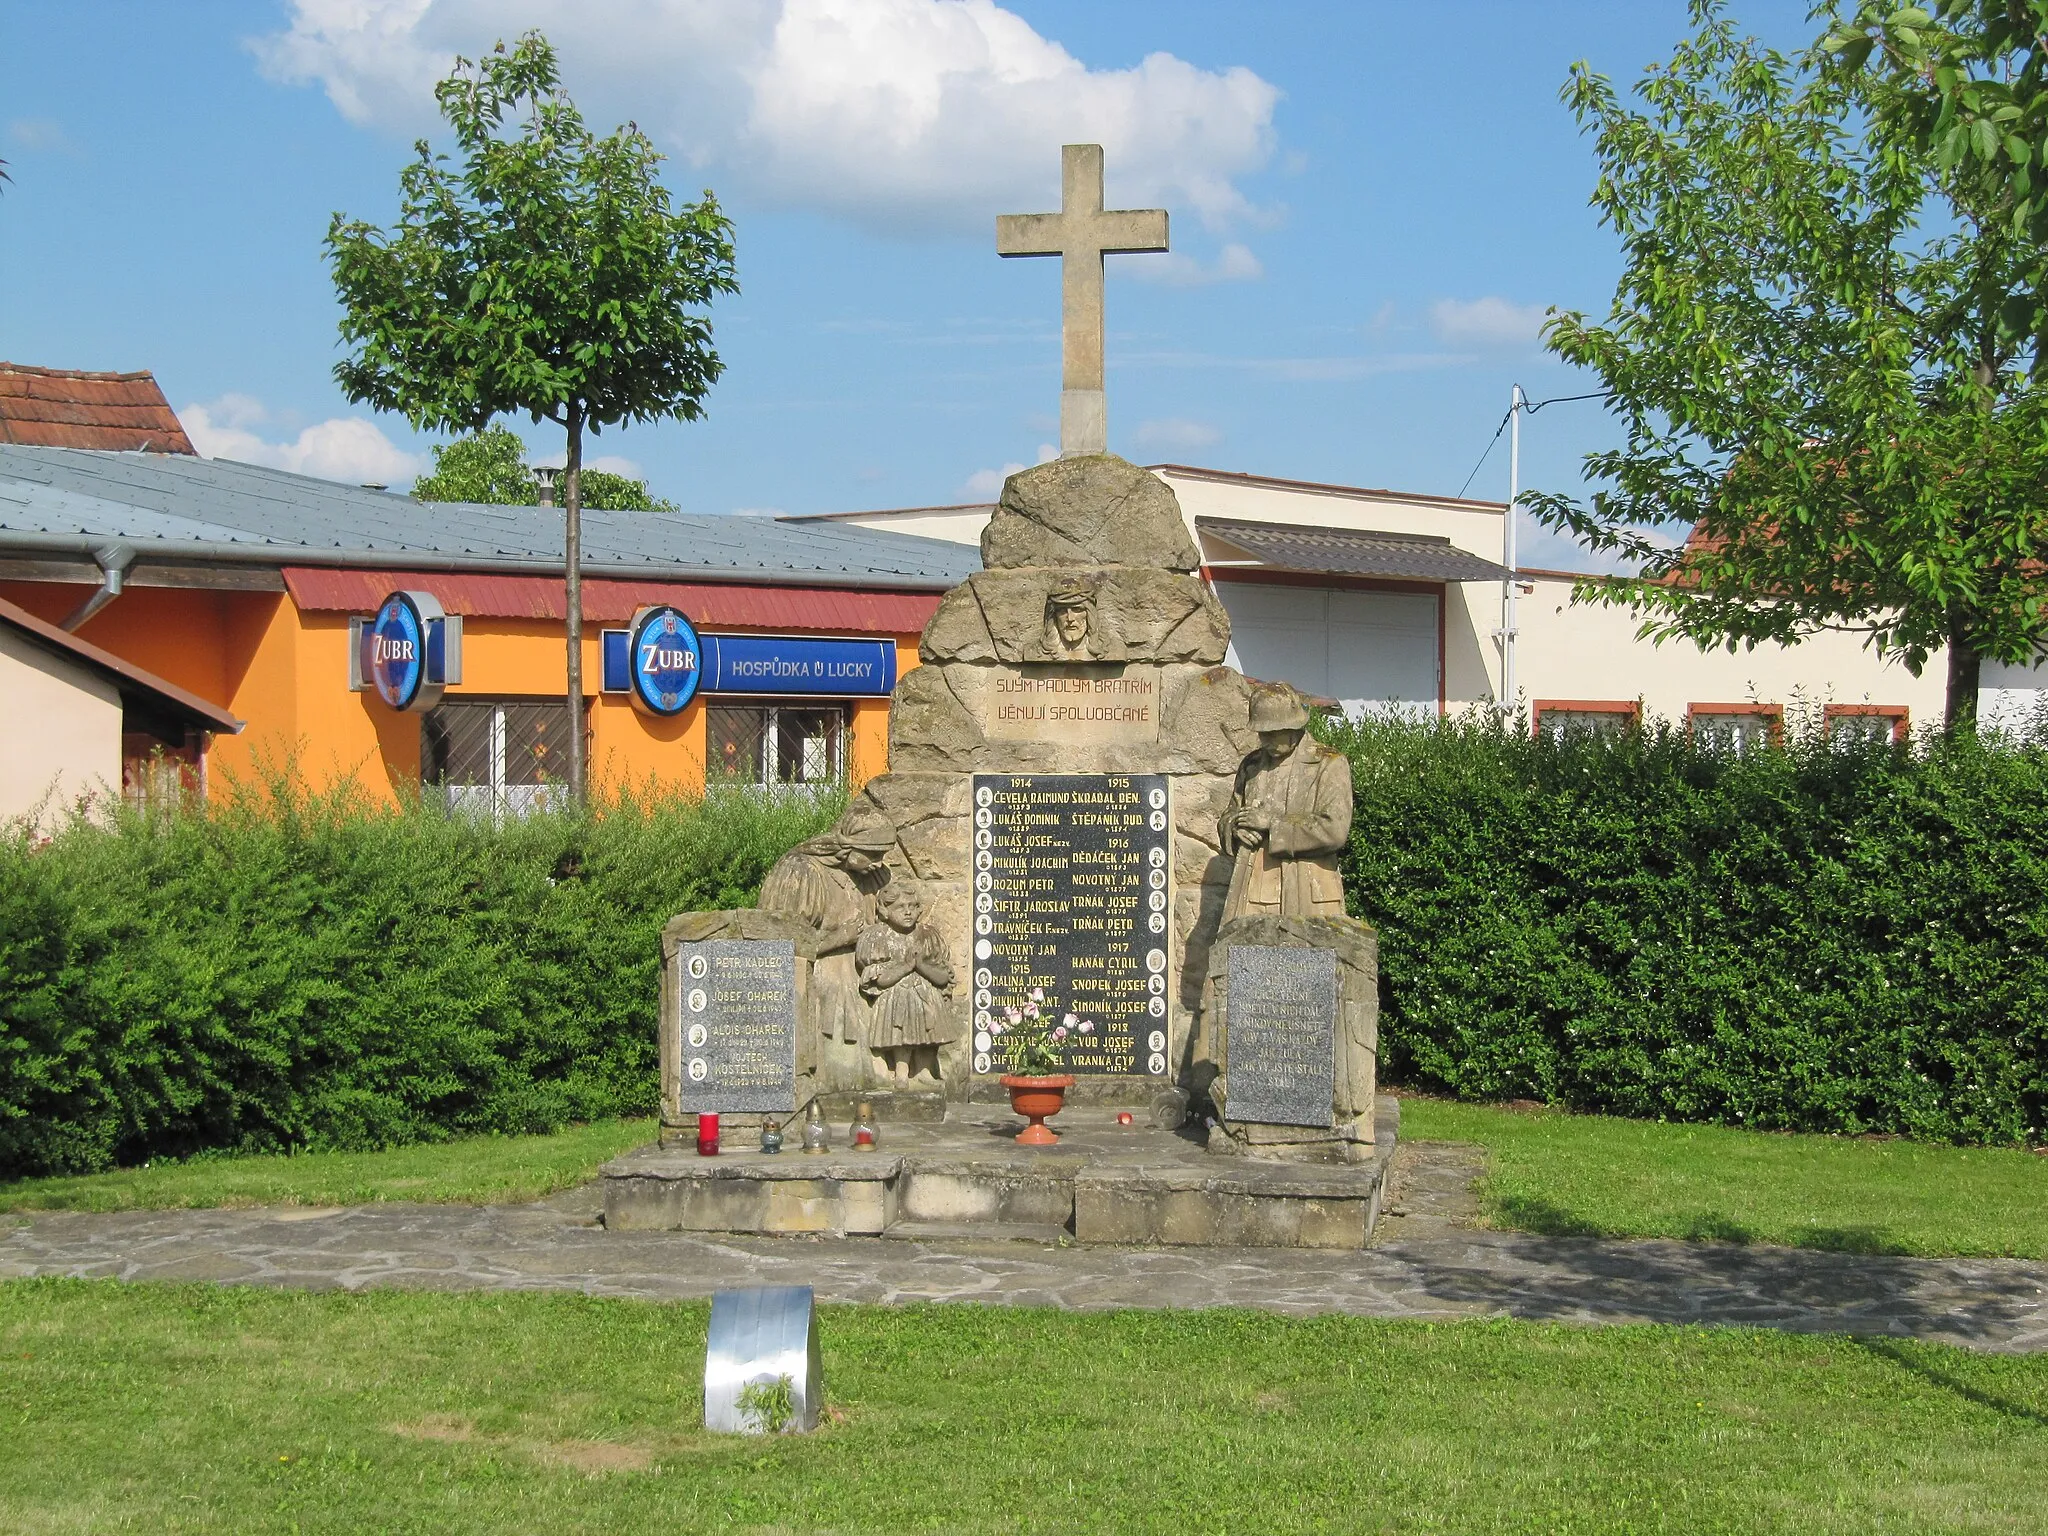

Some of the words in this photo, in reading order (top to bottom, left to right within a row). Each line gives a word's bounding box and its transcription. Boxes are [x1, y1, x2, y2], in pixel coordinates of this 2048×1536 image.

[374, 635, 414, 664] ZUBR
[642, 645, 696, 672] ZUBR
[732, 656, 810, 676] HOSPŮDKA
[828, 662, 872, 677] LUCKY
[1094, 677, 1152, 694] BRATŘÍM
[1050, 704, 1149, 721] SPOLUOBČANÉ
[1011, 778, 1032, 788] 1914
[1108, 778, 1130, 788] 1915
[993, 811, 1022, 824] LUKÁŠ
[993, 832, 1022, 846] LUKÁŠ
[1024, 836, 1053, 846] JOSEF
[1108, 838, 1130, 848] 1916
[1122, 852, 1140, 864] JAN
[1072, 872, 1117, 885] NOVOTNÝ
[1121, 874, 1140, 885] JAN
[1029, 879, 1054, 890] PETR
[1024, 901, 1070, 912] JAROSLAV
[1108, 896, 1138, 908] JOSEF
[1108, 918, 1134, 929] PETR
[1038, 945, 1057, 955] JAN
[1108, 943, 1129, 952] 1917
[1108, 957, 1138, 968] CYRIL
[1010, 964, 1030, 974] 1915
[1027, 976, 1056, 986] JOSEF
[1072, 979, 1111, 990] SNOPEK
[1114, 980, 1146, 991] JOSEF
[1115, 1002, 1147, 1012] JOSEF
[1108, 1023, 1129, 1032] 1918
[1102, 1037, 1135, 1048] JOSEF
